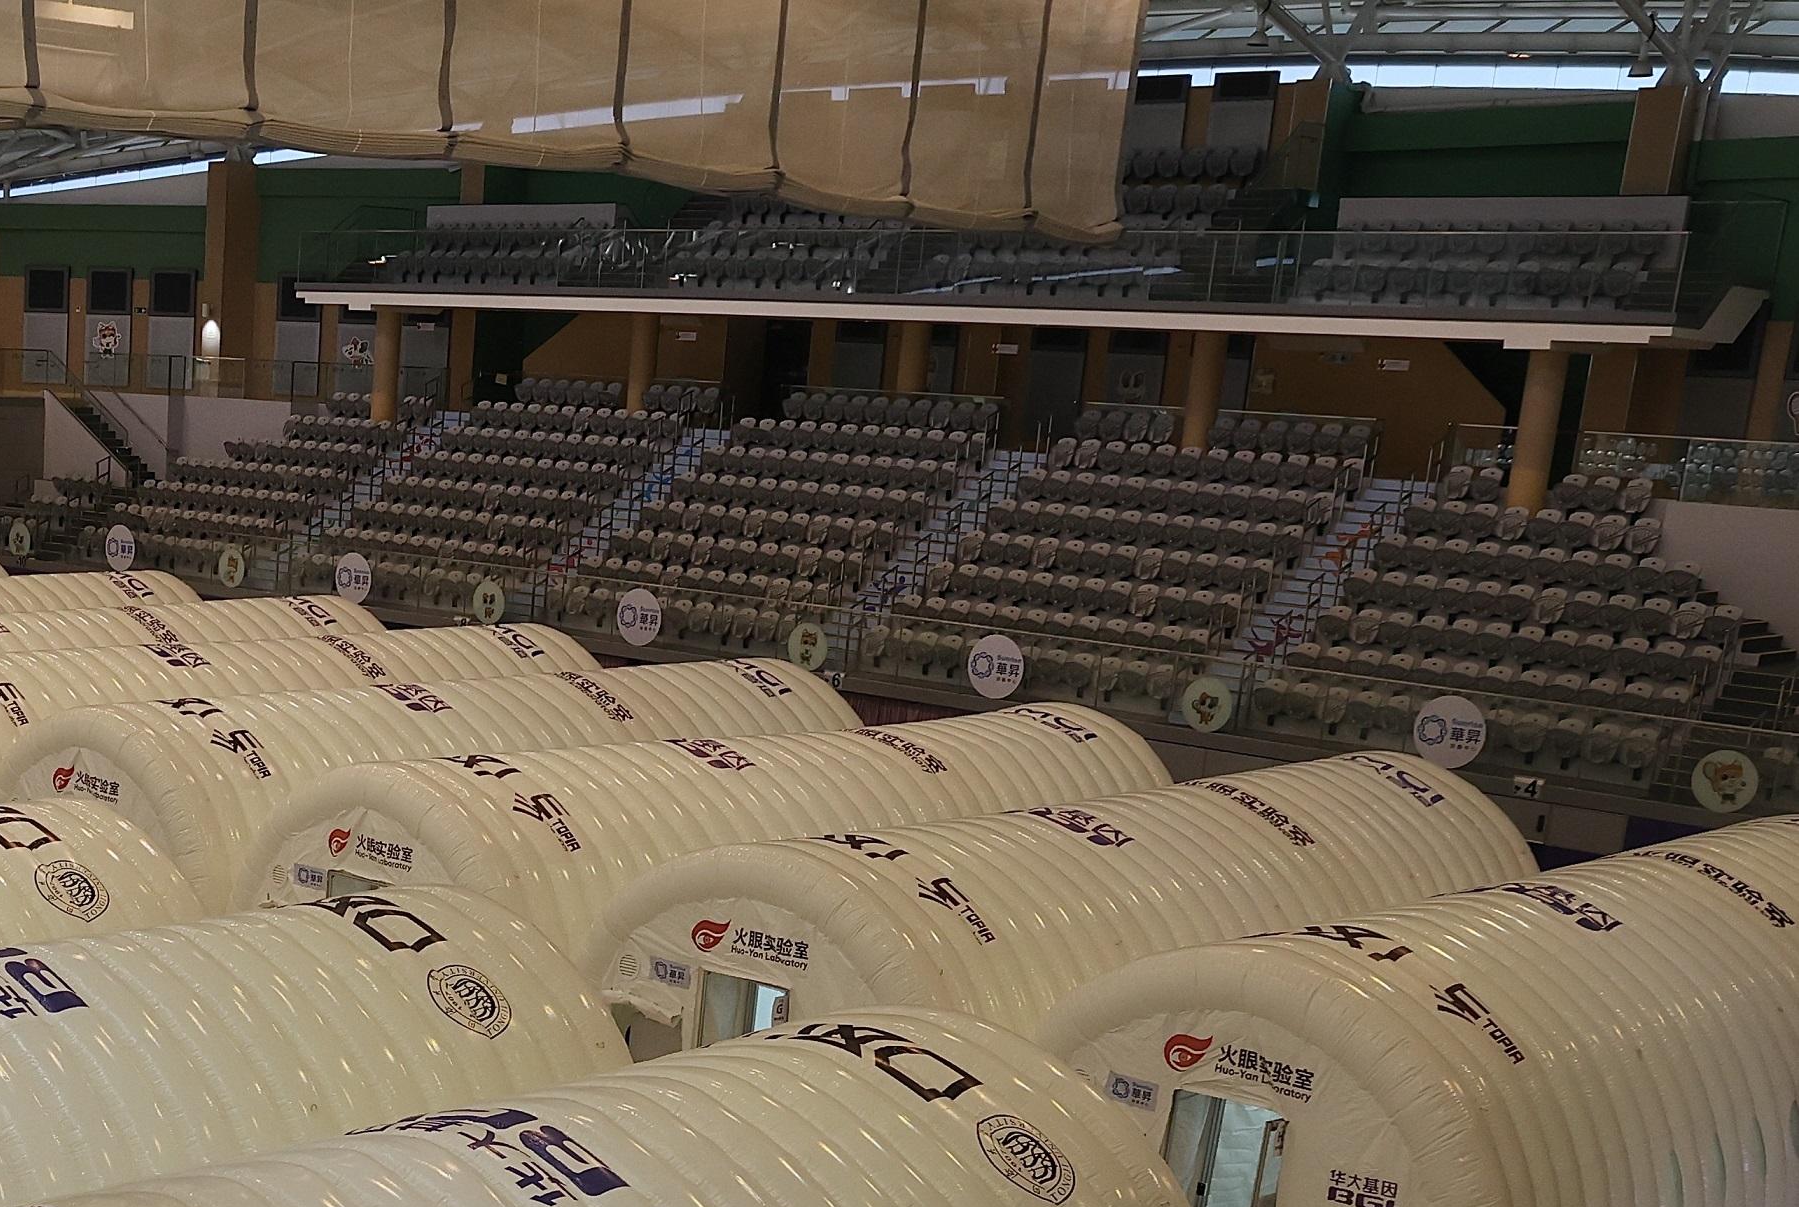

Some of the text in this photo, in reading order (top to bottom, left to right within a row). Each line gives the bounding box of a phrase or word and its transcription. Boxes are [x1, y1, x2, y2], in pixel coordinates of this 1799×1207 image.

[831, 673, 842, 688] 6
[1524, 780, 1538, 798] 4
[733, 927, 810, 960] 火眼实验室
[1214, 1063, 1259, 1083] Huo-Yan
[1329, 1169, 1398, 1199] 华大基因
